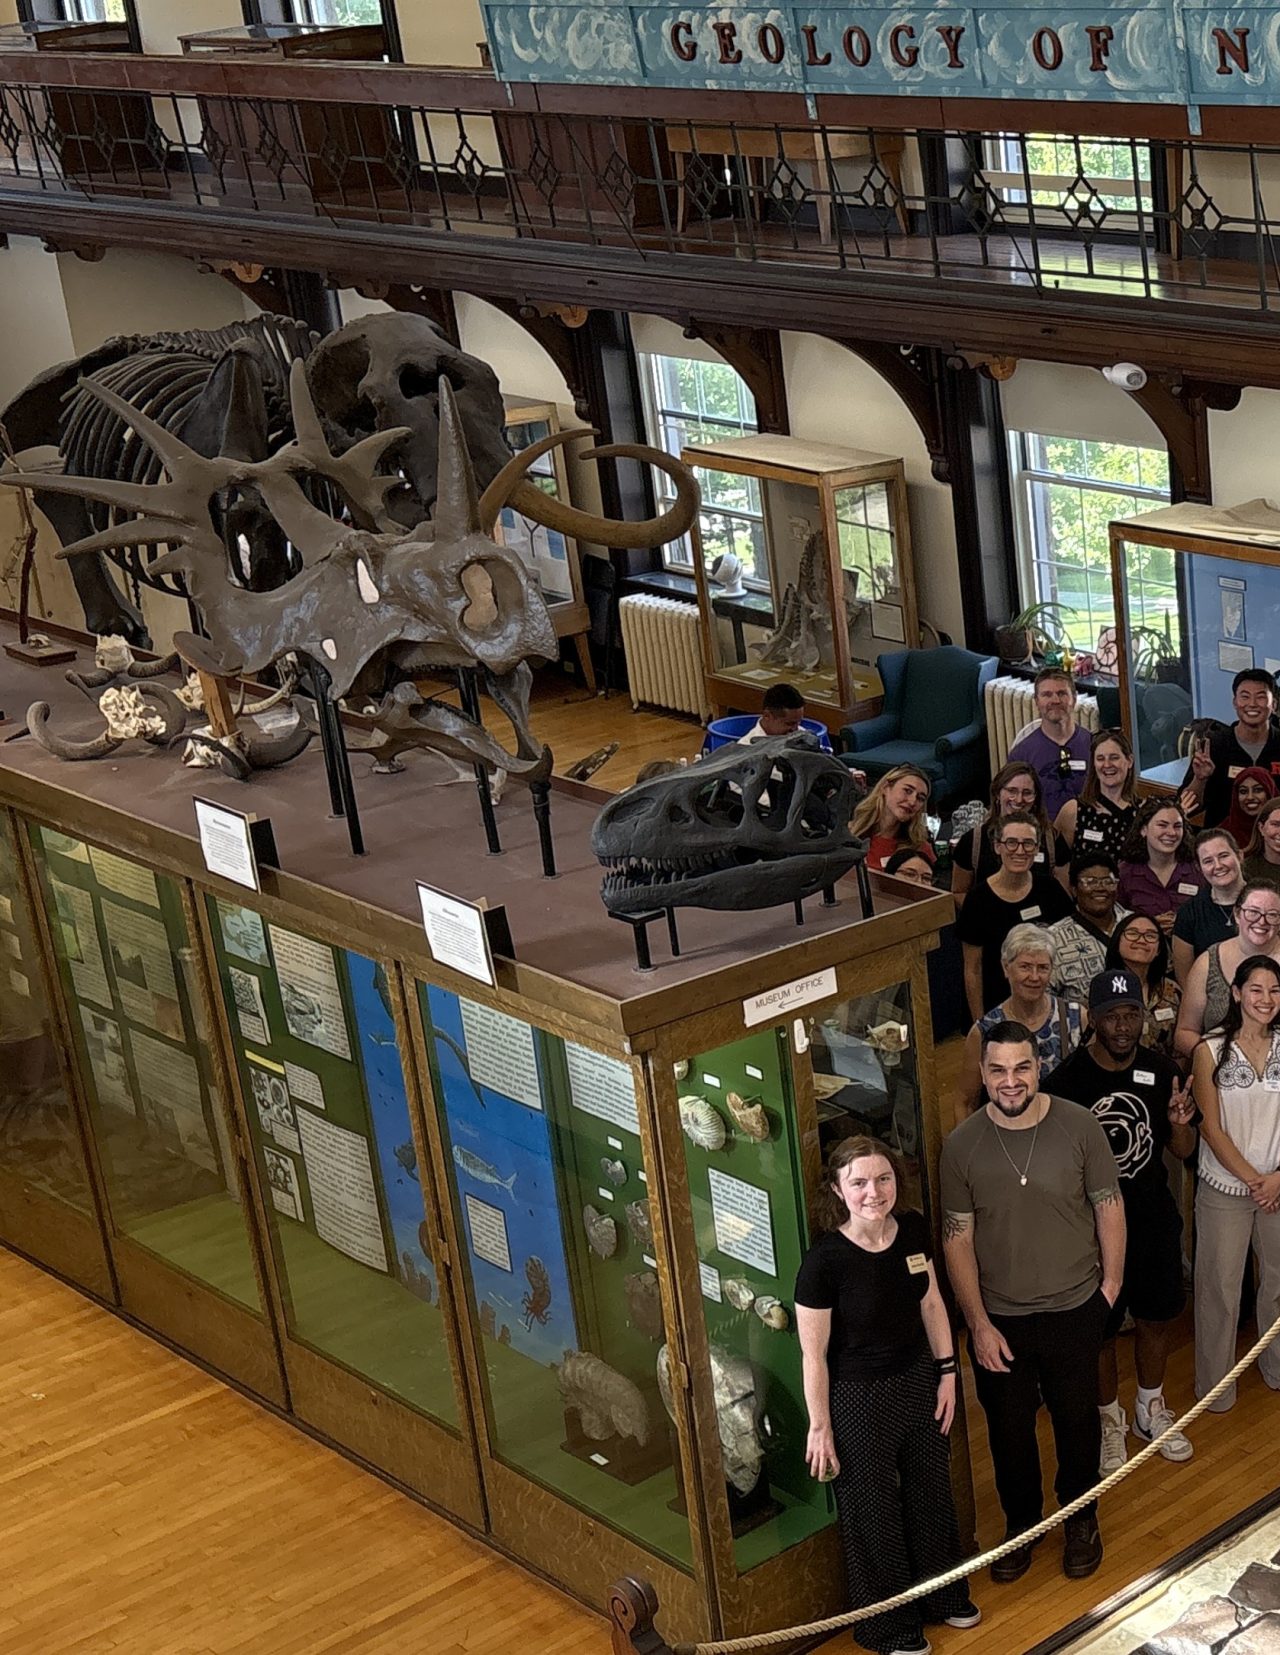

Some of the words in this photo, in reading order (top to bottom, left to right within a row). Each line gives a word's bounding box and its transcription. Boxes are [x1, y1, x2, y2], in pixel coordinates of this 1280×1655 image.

[671, 22, 965, 68] GEOLOGY
[1032, 25, 1114, 72] OF
[755, 989, 791, 1009] MUSEUM
[795, 976, 824, 994] OFFICE
[1112, 976, 1128, 993] NY
